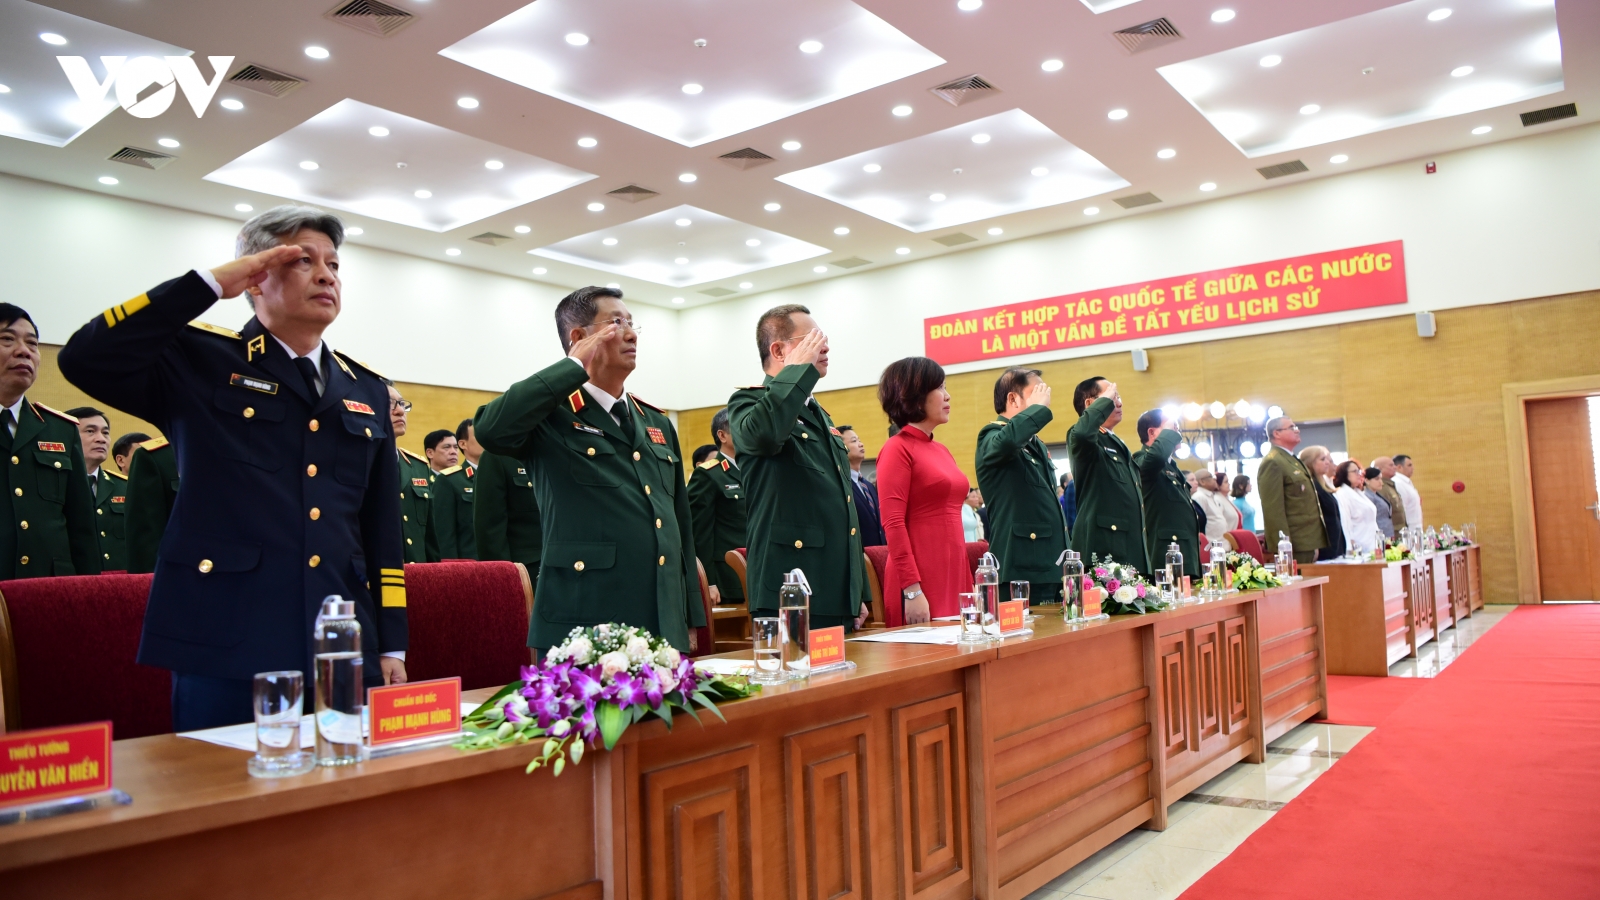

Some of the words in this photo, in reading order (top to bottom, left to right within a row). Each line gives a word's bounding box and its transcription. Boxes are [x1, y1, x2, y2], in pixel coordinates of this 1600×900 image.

[930, 319, 978, 340] ĐOÀN
[983, 309, 1016, 331] KẾT
[1021, 305, 1060, 326] HỢP
[1065, 298, 1103, 318] TÁC
[1109, 285, 1165, 312] QUỐC
[1171, 278, 1197, 302] TẾ
[1204, 273, 1259, 297] GIỮA
[1265, 264, 1314, 288] CÁC
[1321, 252, 1393, 280] NƯỚC
[981, 335, 1004, 354] LÀ
[1009, 329, 1050, 350] MỘT
[1055, 320, 1095, 343] VẤN
[1101, 313, 1127, 337] ĐỀ
[1133, 308, 1171, 332] TẤT
[1177, 301, 1220, 326] YẾU
[1226, 296, 1279, 321] LỊCH
[1286, 285, 1321, 311] SỬ
[380, 715, 404, 734] PHẠM
[405, 712, 429, 730] MẠNH
[430, 707, 452, 725] HÙNG
[0, 764, 36, 794] UYỄN
[39, 763, 66, 787] VĂN
